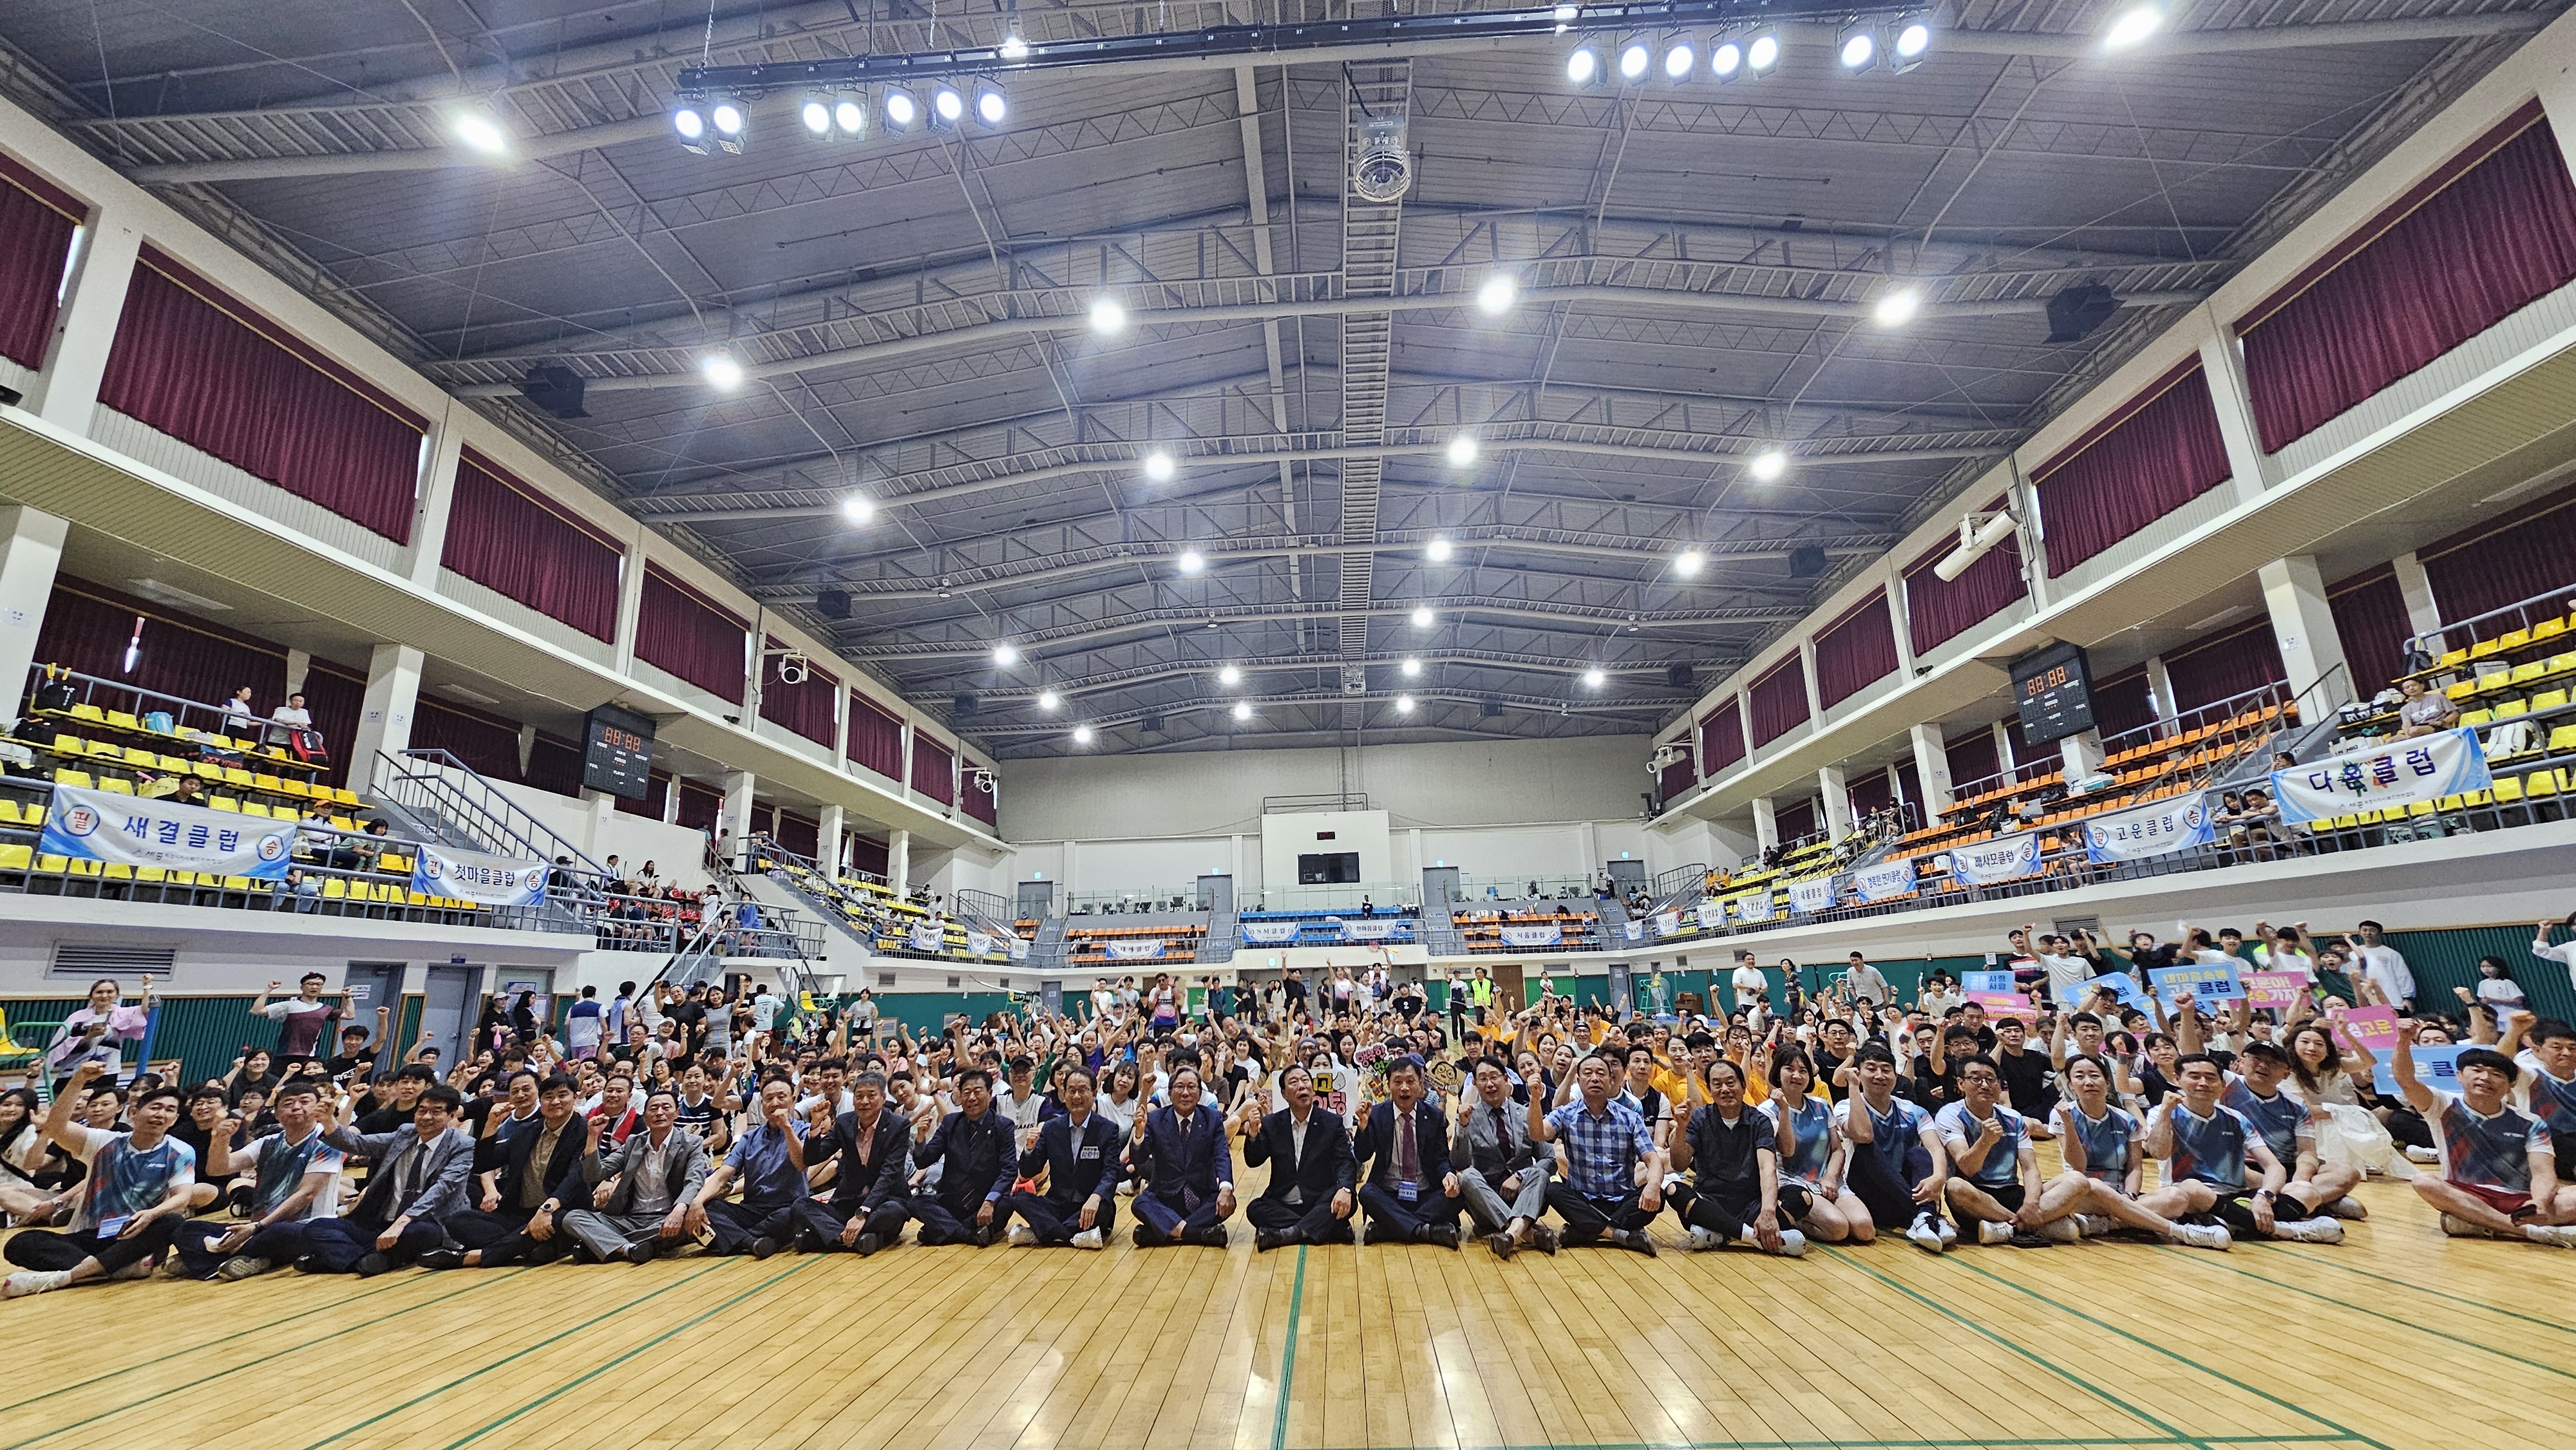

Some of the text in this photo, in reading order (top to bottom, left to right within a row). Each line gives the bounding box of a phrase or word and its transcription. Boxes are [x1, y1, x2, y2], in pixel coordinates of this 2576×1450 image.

[73, 810, 278, 855] 필 새결클럽 승
[2116, 814, 2175, 842] 고운클럽
[2188, 809, 2200, 825] 승
[2023, 847, 2032, 858] 승
[454, 863, 515, 888] 첫마을클럽
[529, 874, 540, 888] 승
[1867, 874, 1882, 889] 행복한
[1882, 869, 1901, 885] 연기클럽
[2166, 980, 2231, 997] 고운클럽
[2342, 1019, 2394, 1038] 승고운
[1355, 1044, 1386, 1068] 행복한
[1312, 1072, 1334, 1093] 고
[1311, 1091, 1347, 1116] 이팅
